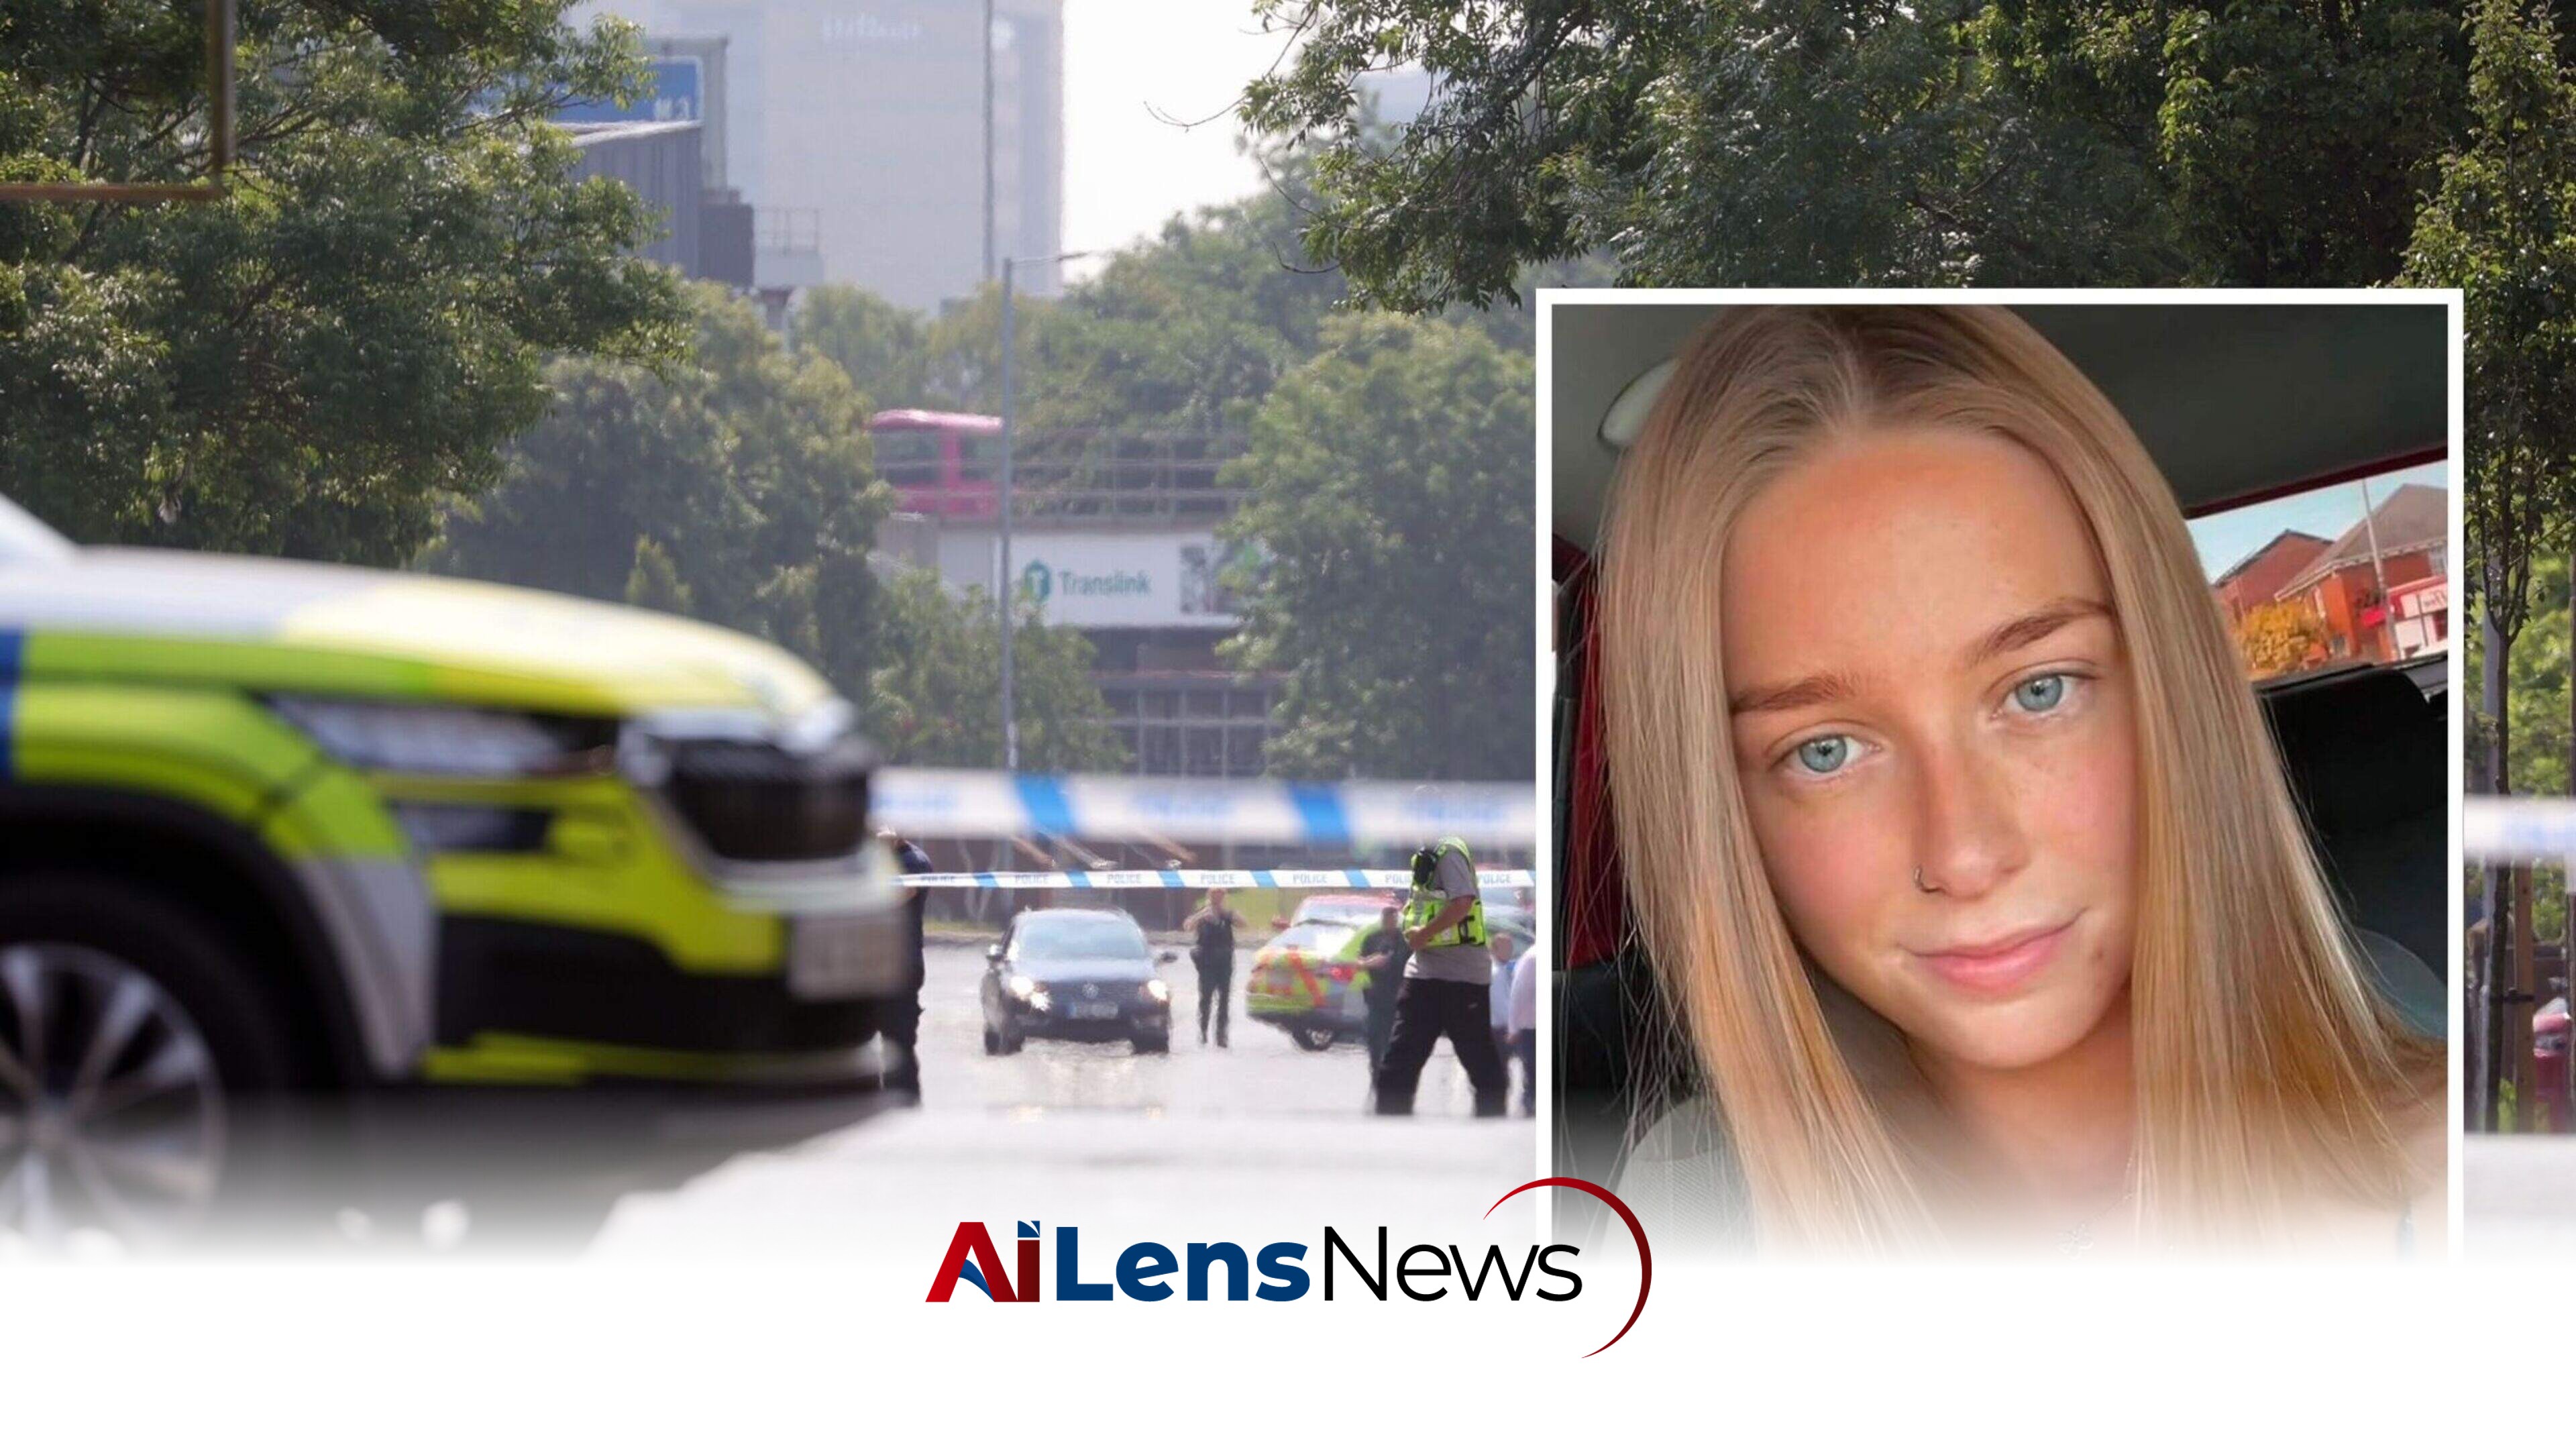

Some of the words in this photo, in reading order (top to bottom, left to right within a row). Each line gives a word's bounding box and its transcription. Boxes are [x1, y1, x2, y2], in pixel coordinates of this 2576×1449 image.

[1059, 569, 1152, 596] Translink
[1015, 873, 1049, 884] POLICE
[1107, 873, 1142, 884] POLICE
[1200, 873, 1236, 884] POLICE
[1293, 873, 1328, 884] POLICE
